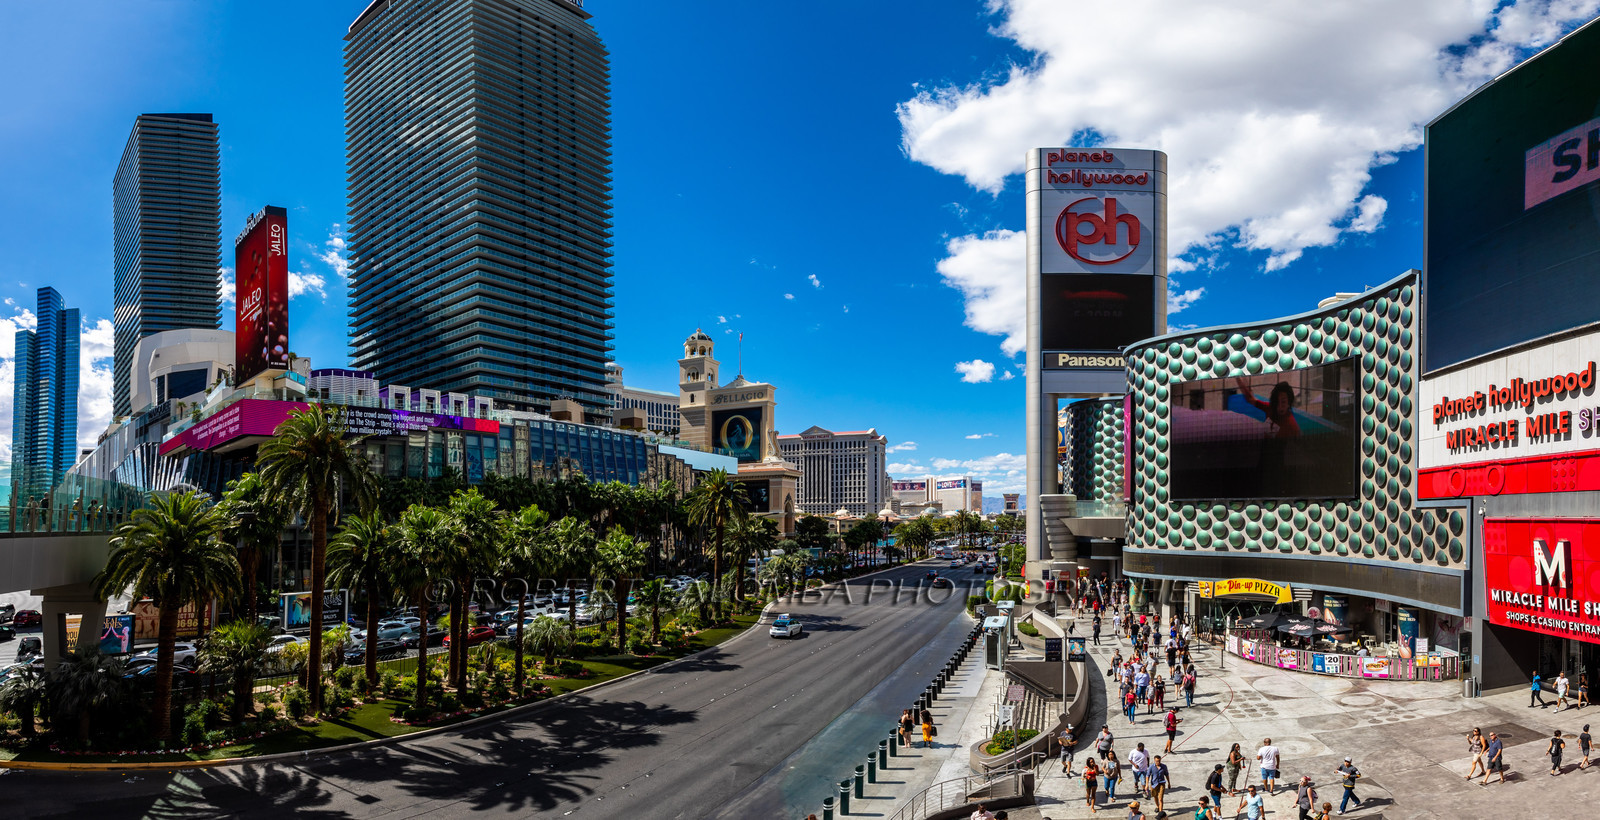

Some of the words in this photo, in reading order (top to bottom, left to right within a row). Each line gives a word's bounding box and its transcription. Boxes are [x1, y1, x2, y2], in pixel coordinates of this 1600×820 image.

[1047, 149, 1114, 166] planet
[1047, 169, 1148, 187] hollywood
[270, 224, 281, 256] JALEO
[1065, 198, 1140, 258] ph
[240, 287, 262, 315] JALEO
[711, 391, 764, 405] BELLAGIO
[1433, 391, 1484, 425] planet
[1489, 361, 1593, 407] hollywood
[1446, 419, 1516, 449] MIRACLE
[1525, 410, 1569, 437] MILE
[1227, 580, 1253, 592] Pin-up
[1255, 582, 1280, 597] PIZZA
[1491, 588, 1543, 608] MIRACLE
[1548, 596, 1578, 613] MILE
[1506, 611, 1529, 623] SHOPS
[1530, 615, 1536, 624] &
[1537, 616, 1567, 629] CASINO
